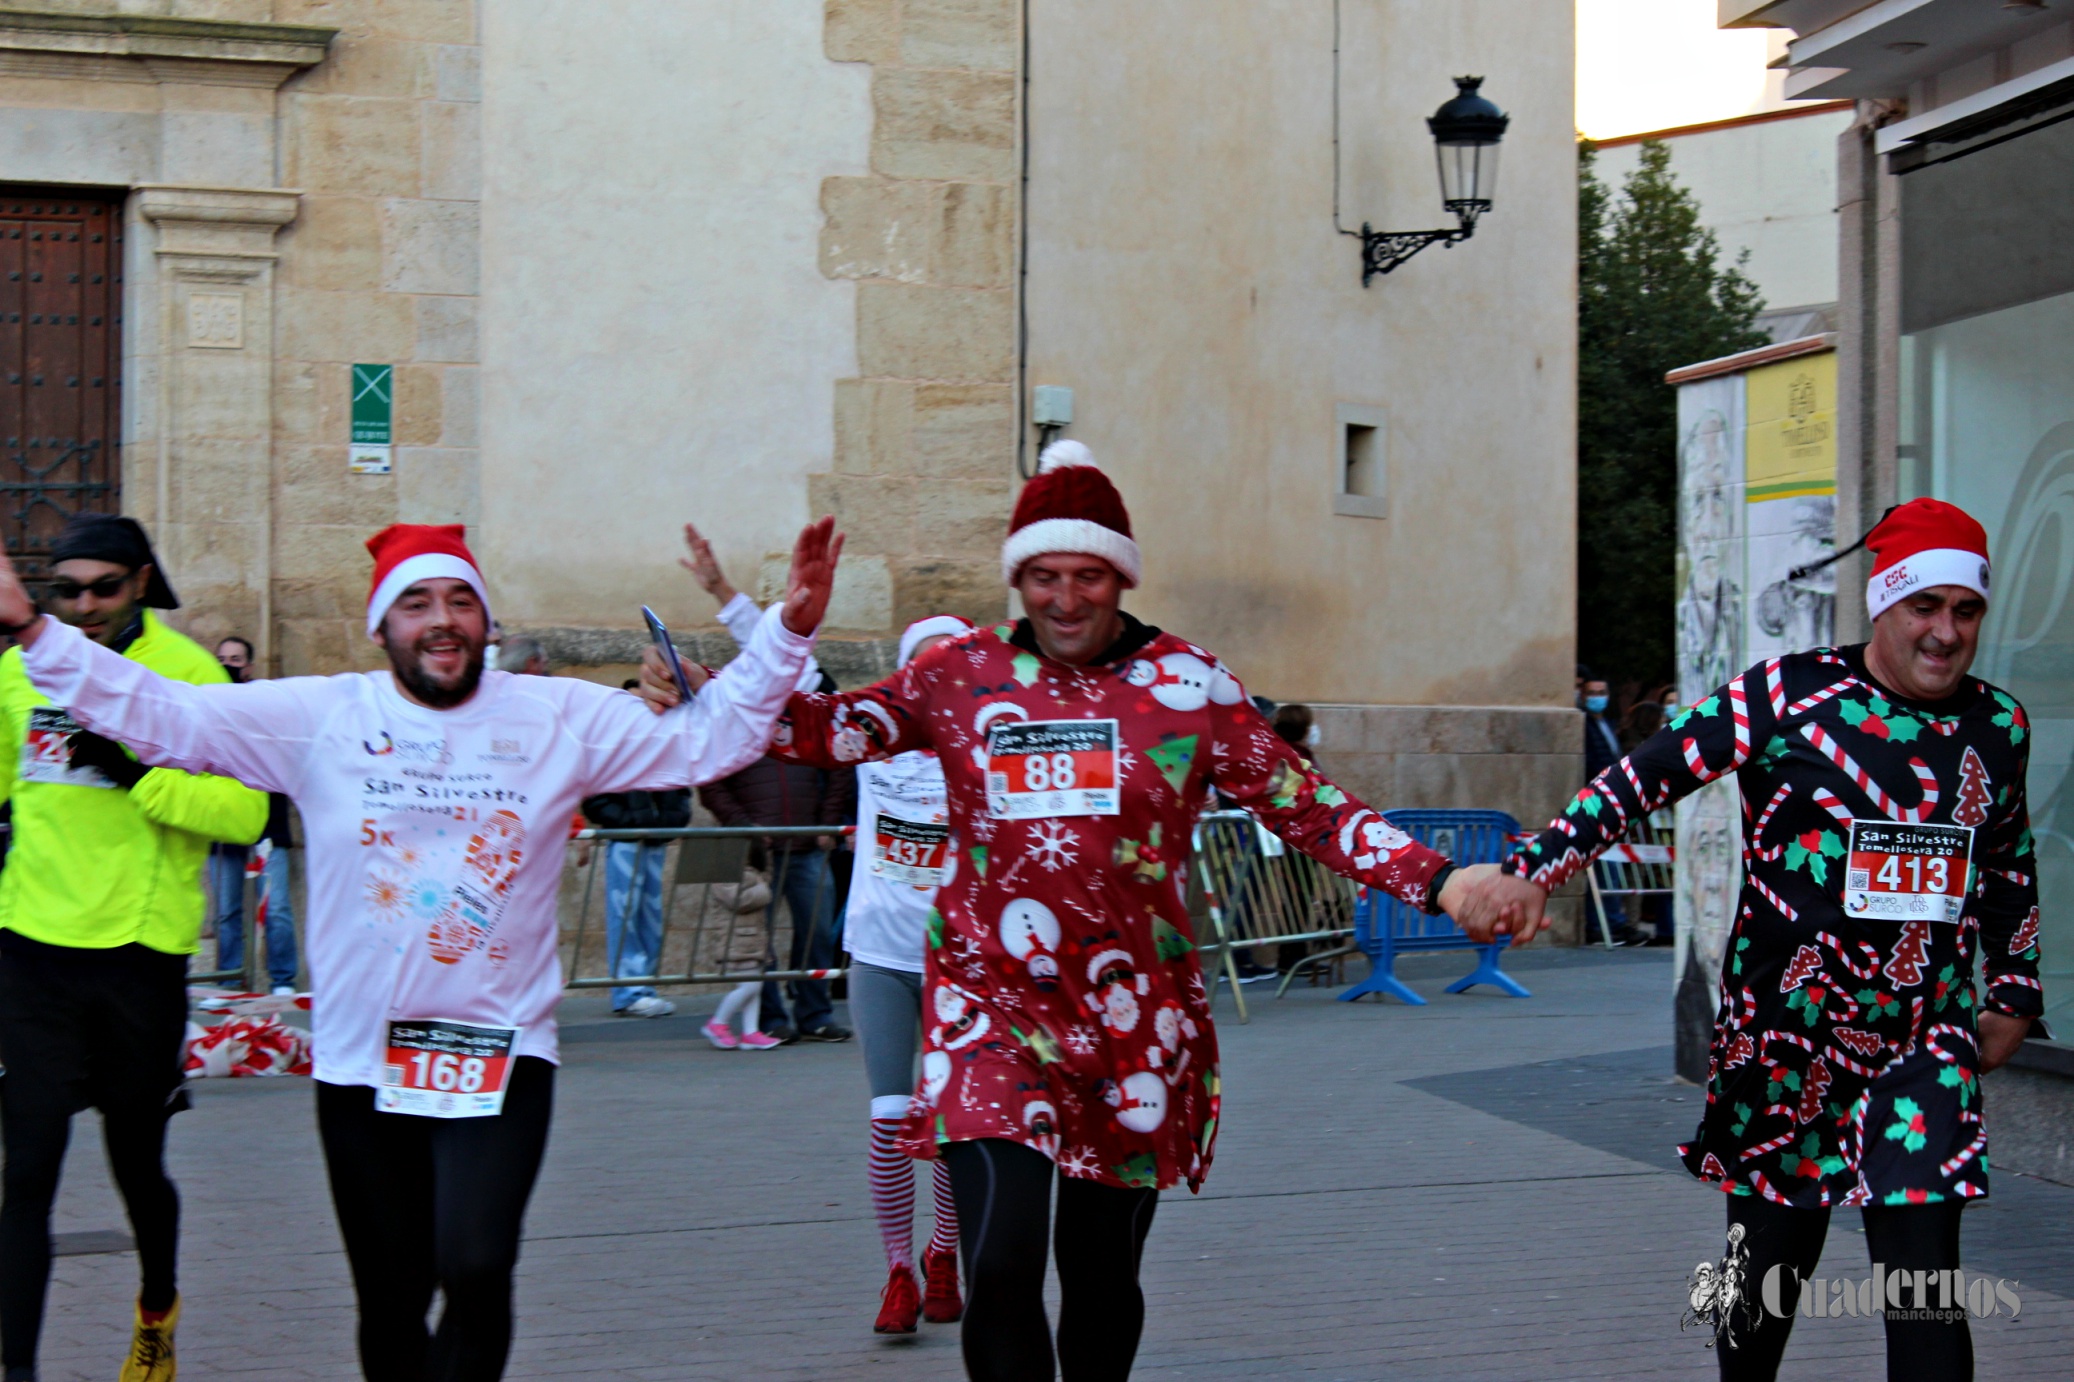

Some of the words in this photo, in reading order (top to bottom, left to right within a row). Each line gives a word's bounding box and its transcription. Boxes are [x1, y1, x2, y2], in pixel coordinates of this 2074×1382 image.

[1024, 753, 1077, 791] 88
[363, 777, 404, 794] San
[415, 784, 529, 804] Silvestre
[360, 818, 395, 847] 5K
[1860, 831, 1889, 842] San
[1895, 832, 1964, 847] Silvestre
[1914, 826, 1939, 834] GRUPO
[1941, 828, 1964, 836] SURCO
[888, 839, 937, 867] 437
[1858, 843, 1933, 855] Tomellosera
[1876, 855, 1949, 894] 413
[1869, 904, 1903, 914] SURCO
[1870, 895, 1897, 905] GRUPO
[411, 1052, 487, 1093] 168
